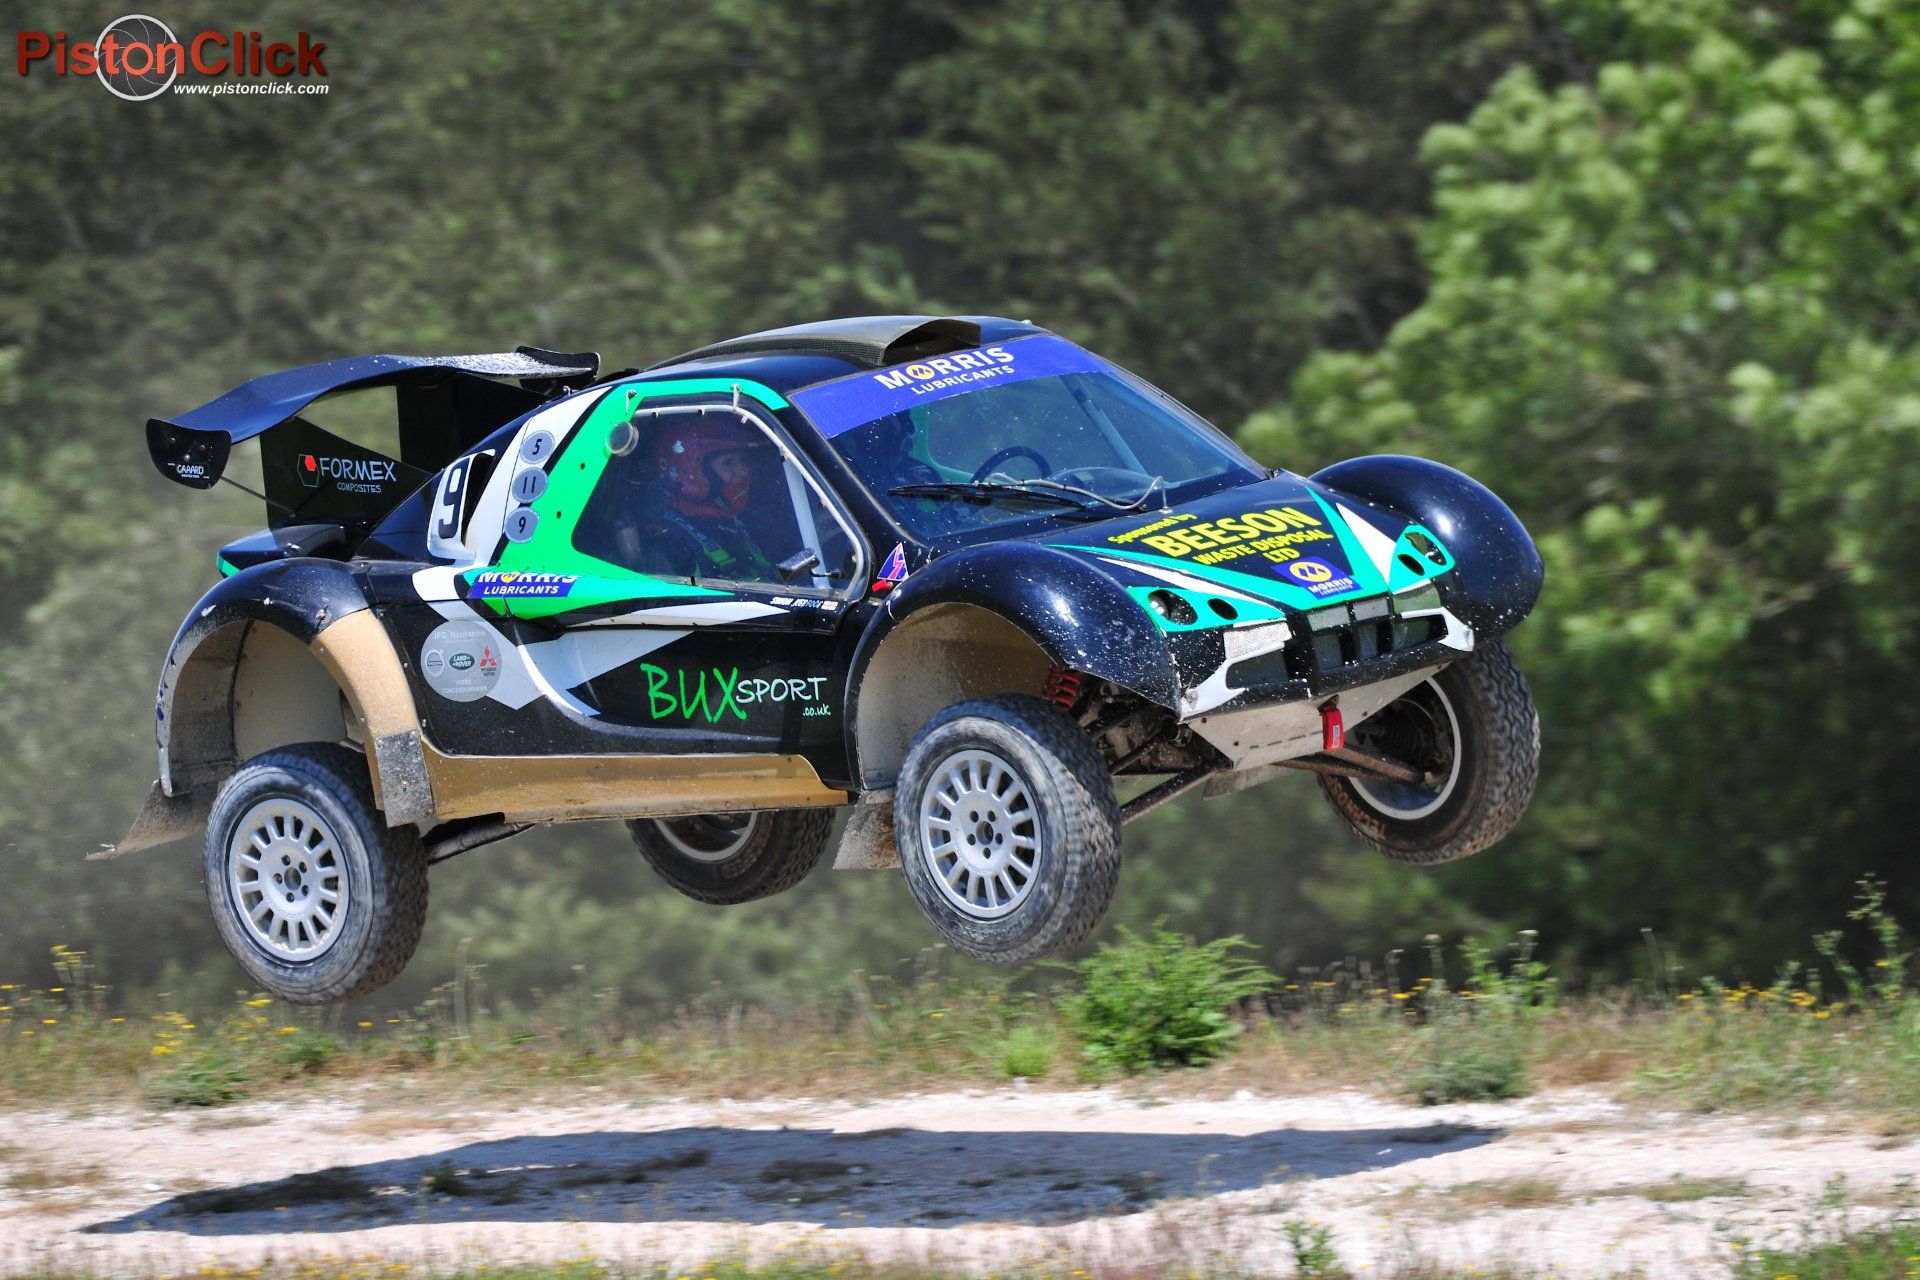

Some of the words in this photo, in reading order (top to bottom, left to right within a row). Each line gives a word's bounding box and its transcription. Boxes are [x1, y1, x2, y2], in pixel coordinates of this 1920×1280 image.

[873, 347, 1014, 390] MORRIS
[911, 365, 1015, 395] LUBRICANTS
[532, 438, 542, 455] 5
[319, 457, 398, 482] FORMEX
[337, 483, 382, 493] COMPOSITES
[522, 475, 537, 494] 11
[438, 456, 470, 539] 9
[518, 516, 527, 533] 9
[1107, 516, 1178, 544] Sponsored
[1140, 507, 1322, 557] BEESON
[1192, 544, 1257, 565] WASTE
[1250, 529, 1333, 551] DISPOSAL
[1263, 548, 1300, 563] LTD
[483, 585, 560, 595] LUBRICANTS
[1307, 577, 1353, 593] MORRIS
[802, 703, 831, 717] .co.uk
